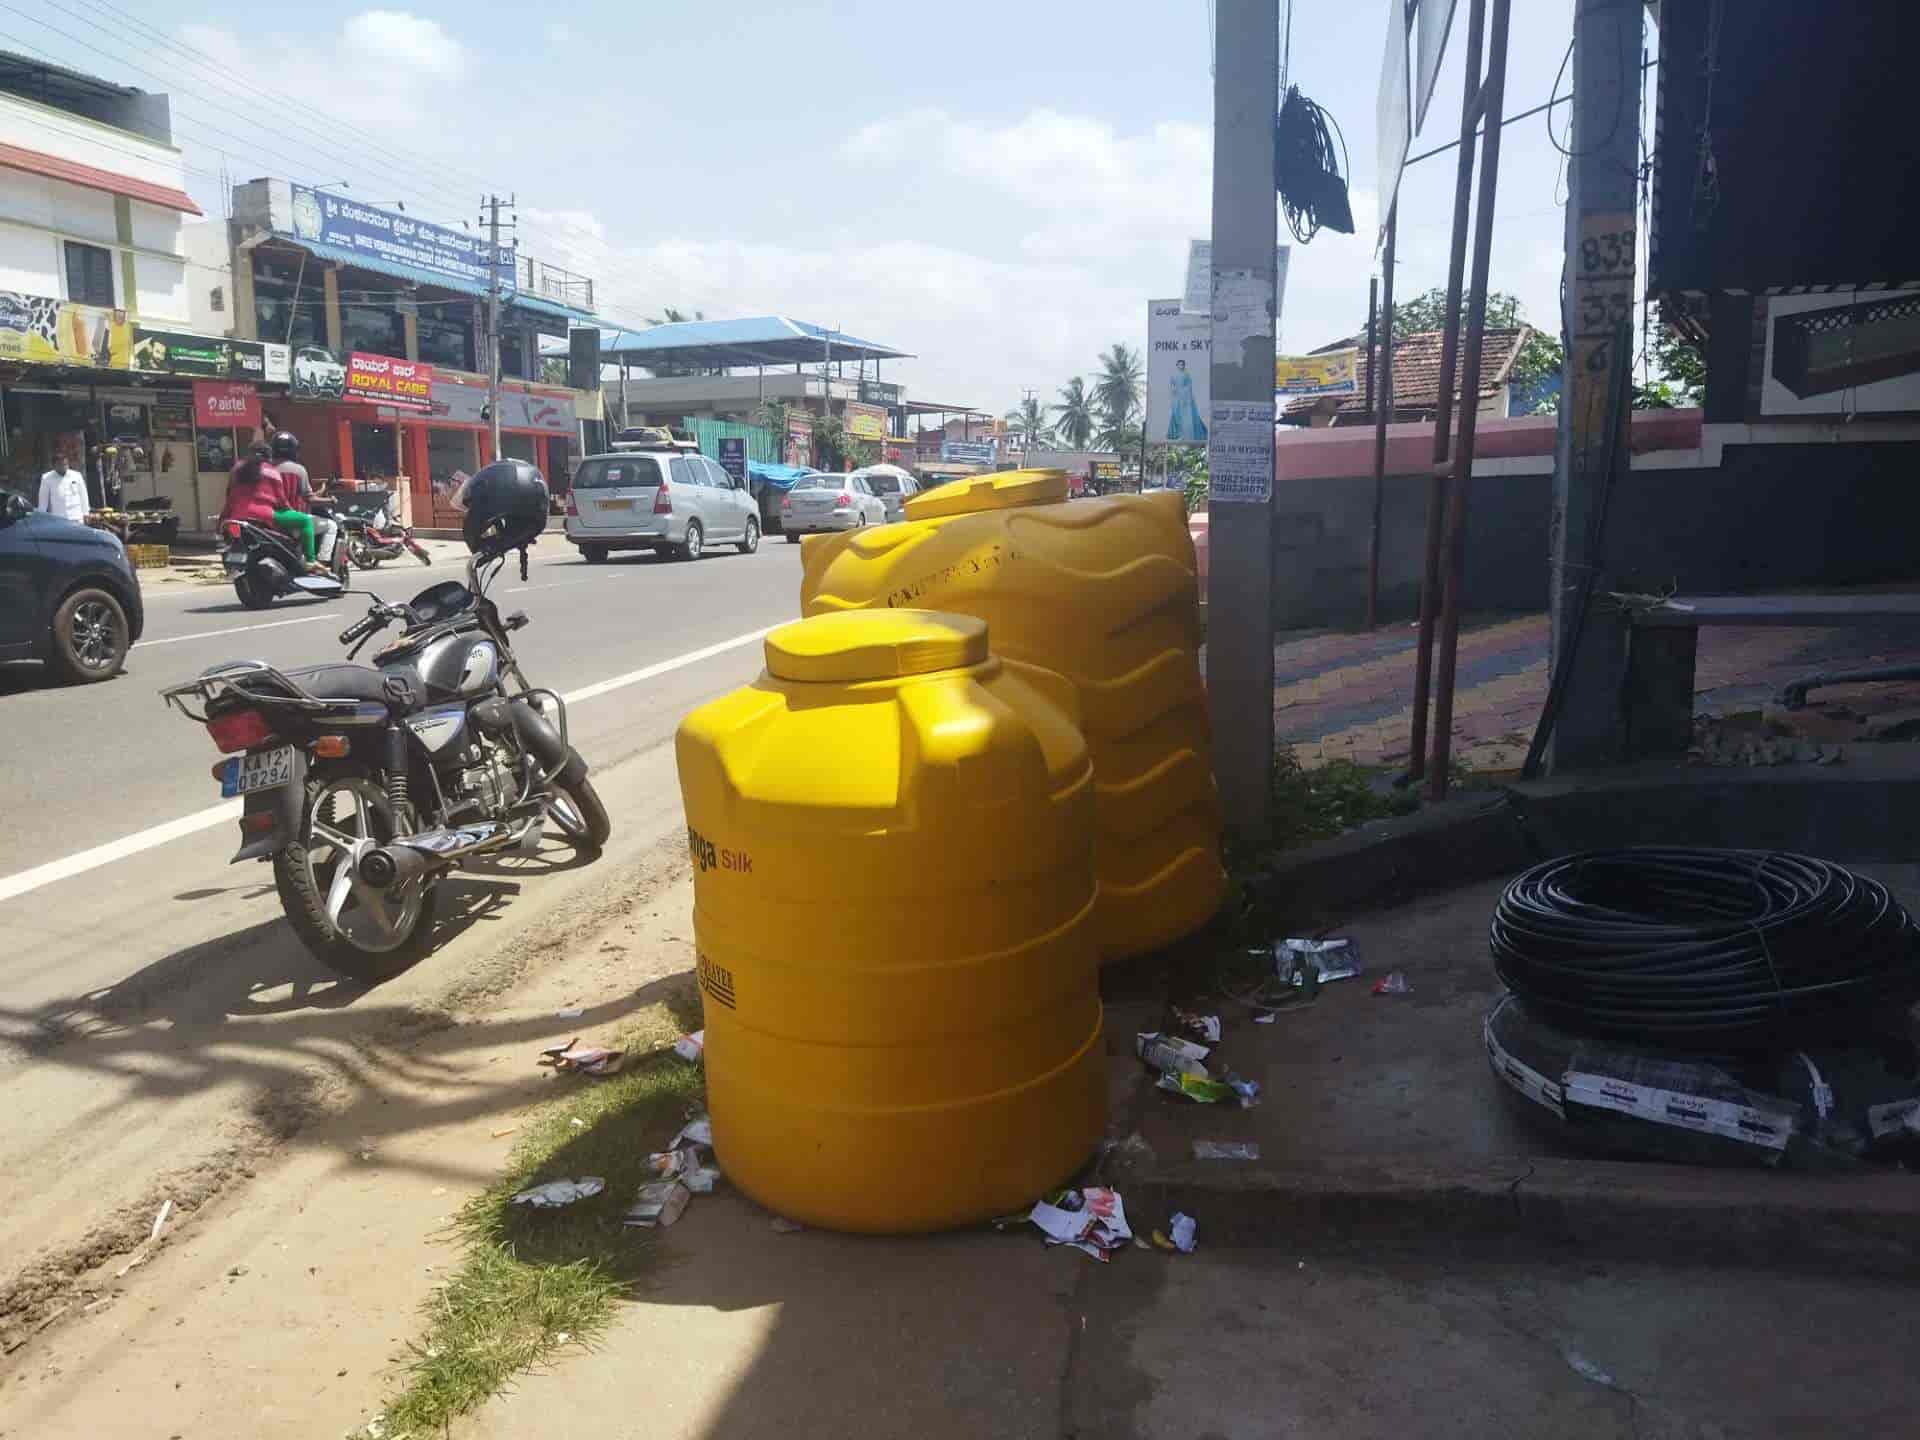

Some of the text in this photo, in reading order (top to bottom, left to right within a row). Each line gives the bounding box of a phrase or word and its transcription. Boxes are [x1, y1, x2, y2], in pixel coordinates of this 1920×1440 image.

[1155, 340, 1179, 352] PINK
[352, 373, 428, 395] ROYAL CARS
[218, 395, 247, 410] airtel
[720, 848, 753, 875] Silk
